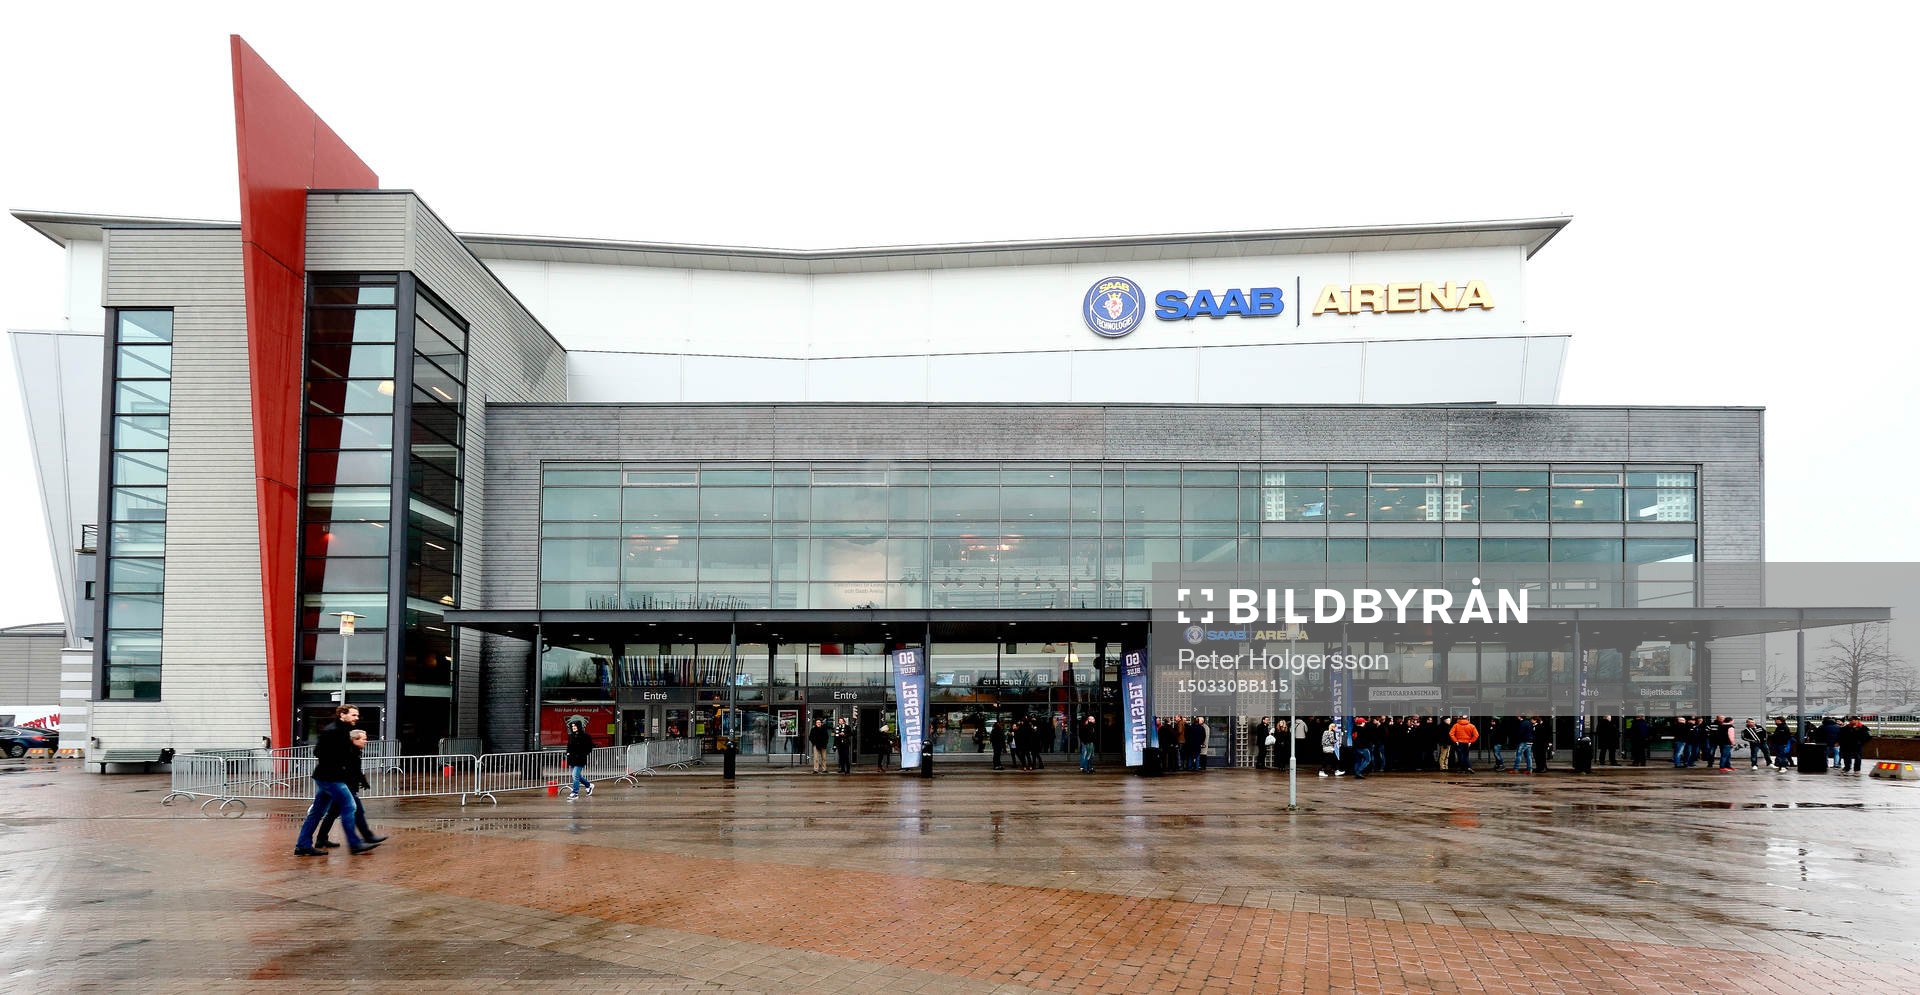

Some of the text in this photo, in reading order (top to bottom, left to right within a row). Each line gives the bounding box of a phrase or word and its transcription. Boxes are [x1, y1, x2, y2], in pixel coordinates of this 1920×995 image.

[1099, 281, 1130, 293] SAAB
[1155, 280, 1496, 320] SAAB ARENA
[1207, 630, 1247, 640] SAAB
[1255, 630, 1309, 640] AREA
[643, 691, 668, 700] Entré
[833, 691, 858, 700] Entré
[1640, 688, 1682, 697] Biljettkassa
